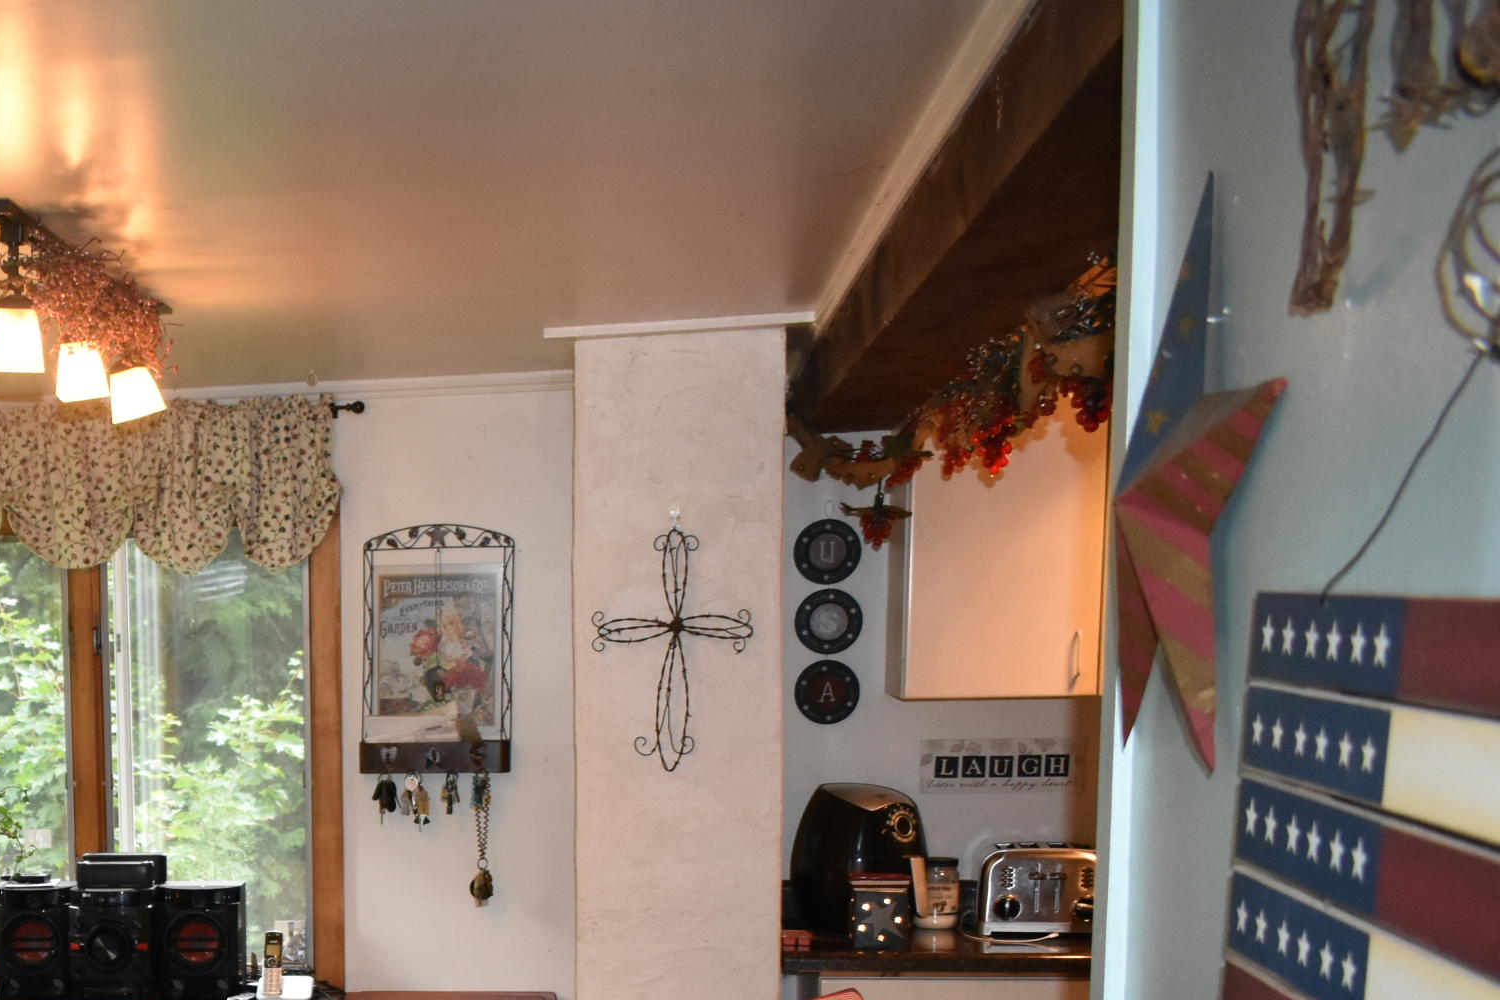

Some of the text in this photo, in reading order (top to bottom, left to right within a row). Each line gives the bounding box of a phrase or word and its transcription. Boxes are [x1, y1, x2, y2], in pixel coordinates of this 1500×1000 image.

[380, 621, 418, 639] GARDEN
[819, 611, 838, 633] S
[817, 681, 836, 703] A
[938, 756, 1067, 776] LAUGH
[1001, 778, 1037, 791] happy
